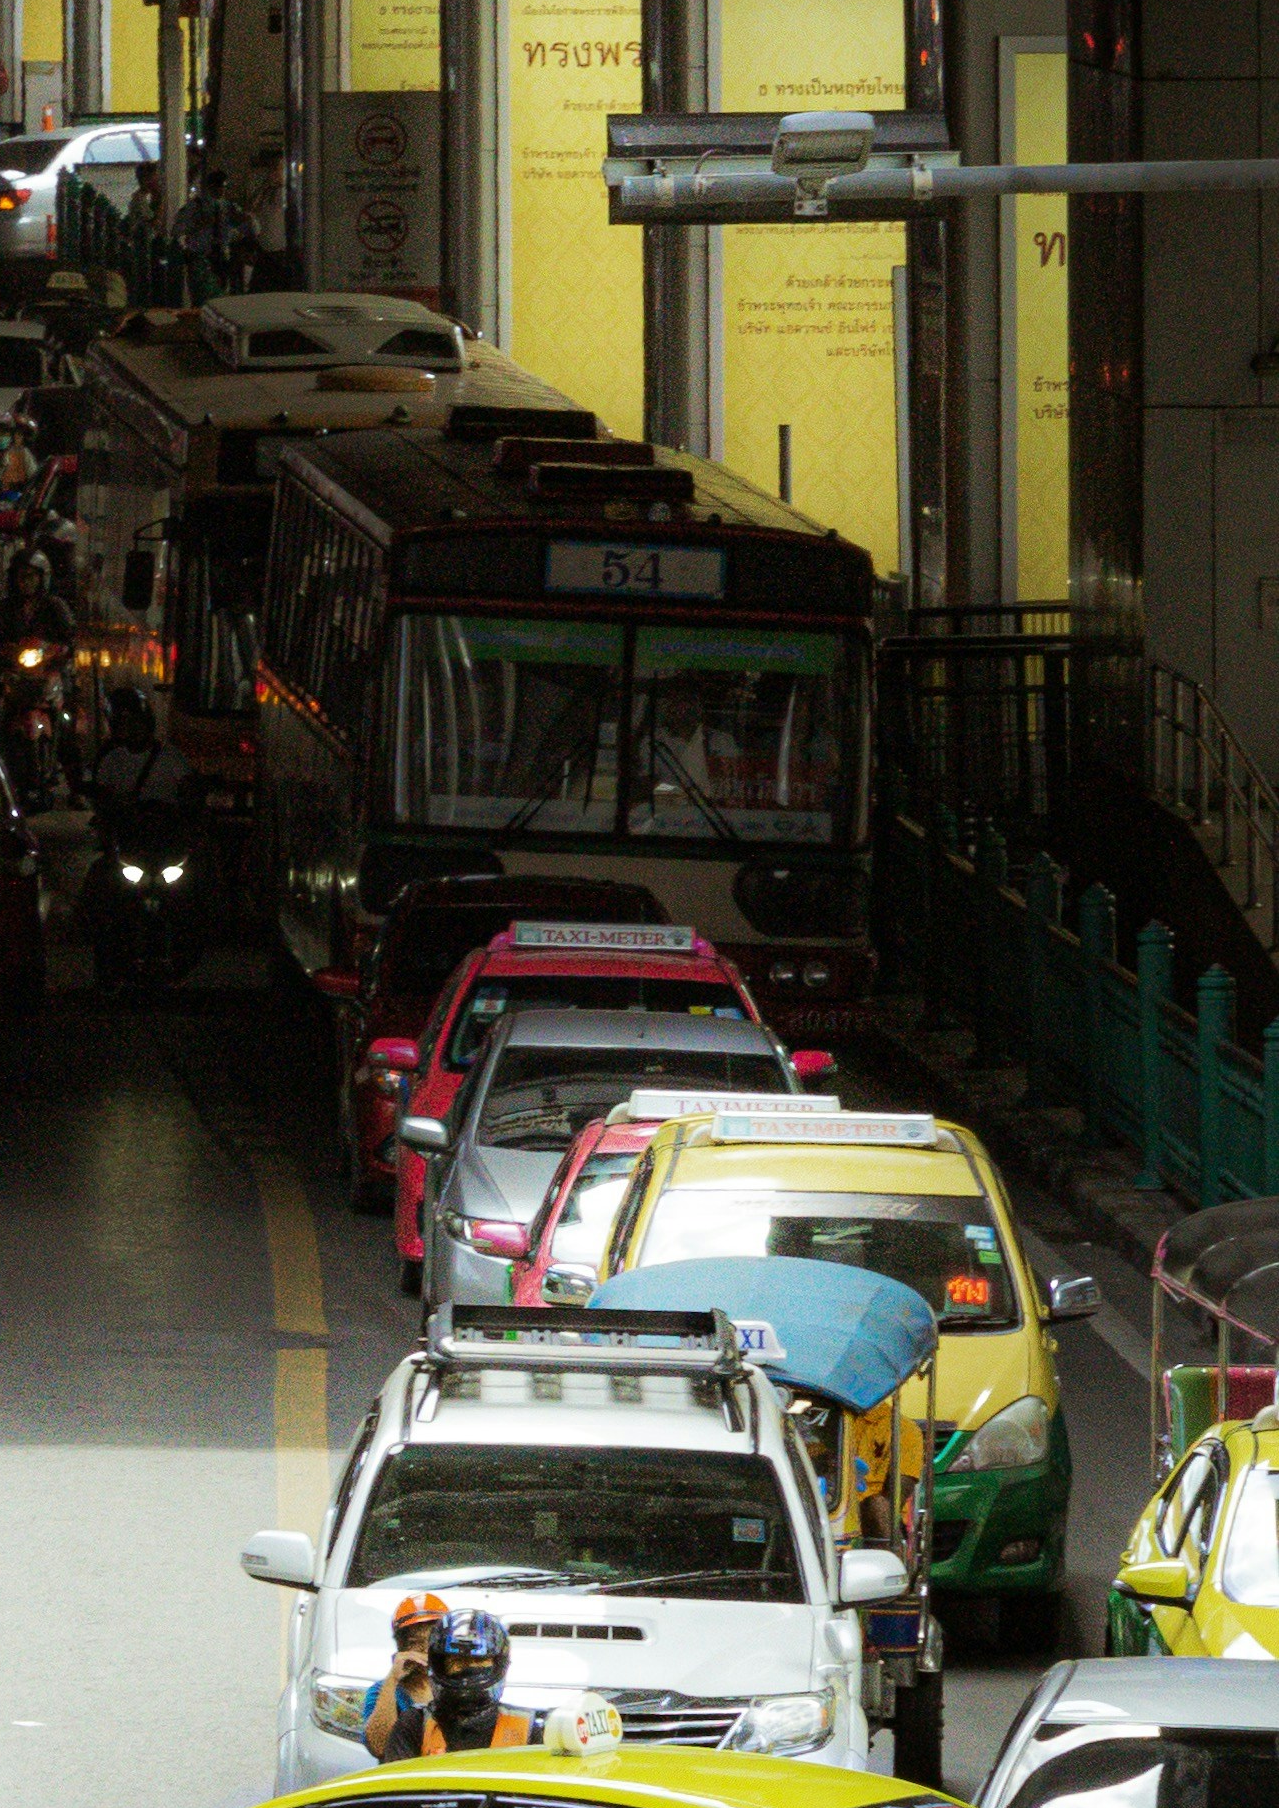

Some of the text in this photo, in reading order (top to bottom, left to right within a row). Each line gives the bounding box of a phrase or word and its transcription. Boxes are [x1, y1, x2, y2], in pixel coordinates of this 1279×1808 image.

[601, 549, 666, 589] 54
[541, 928, 667, 947] TAXI-METER
[751, 1120, 898, 1139] TAXI-METER
[585, 1709, 610, 1737] TAXI
